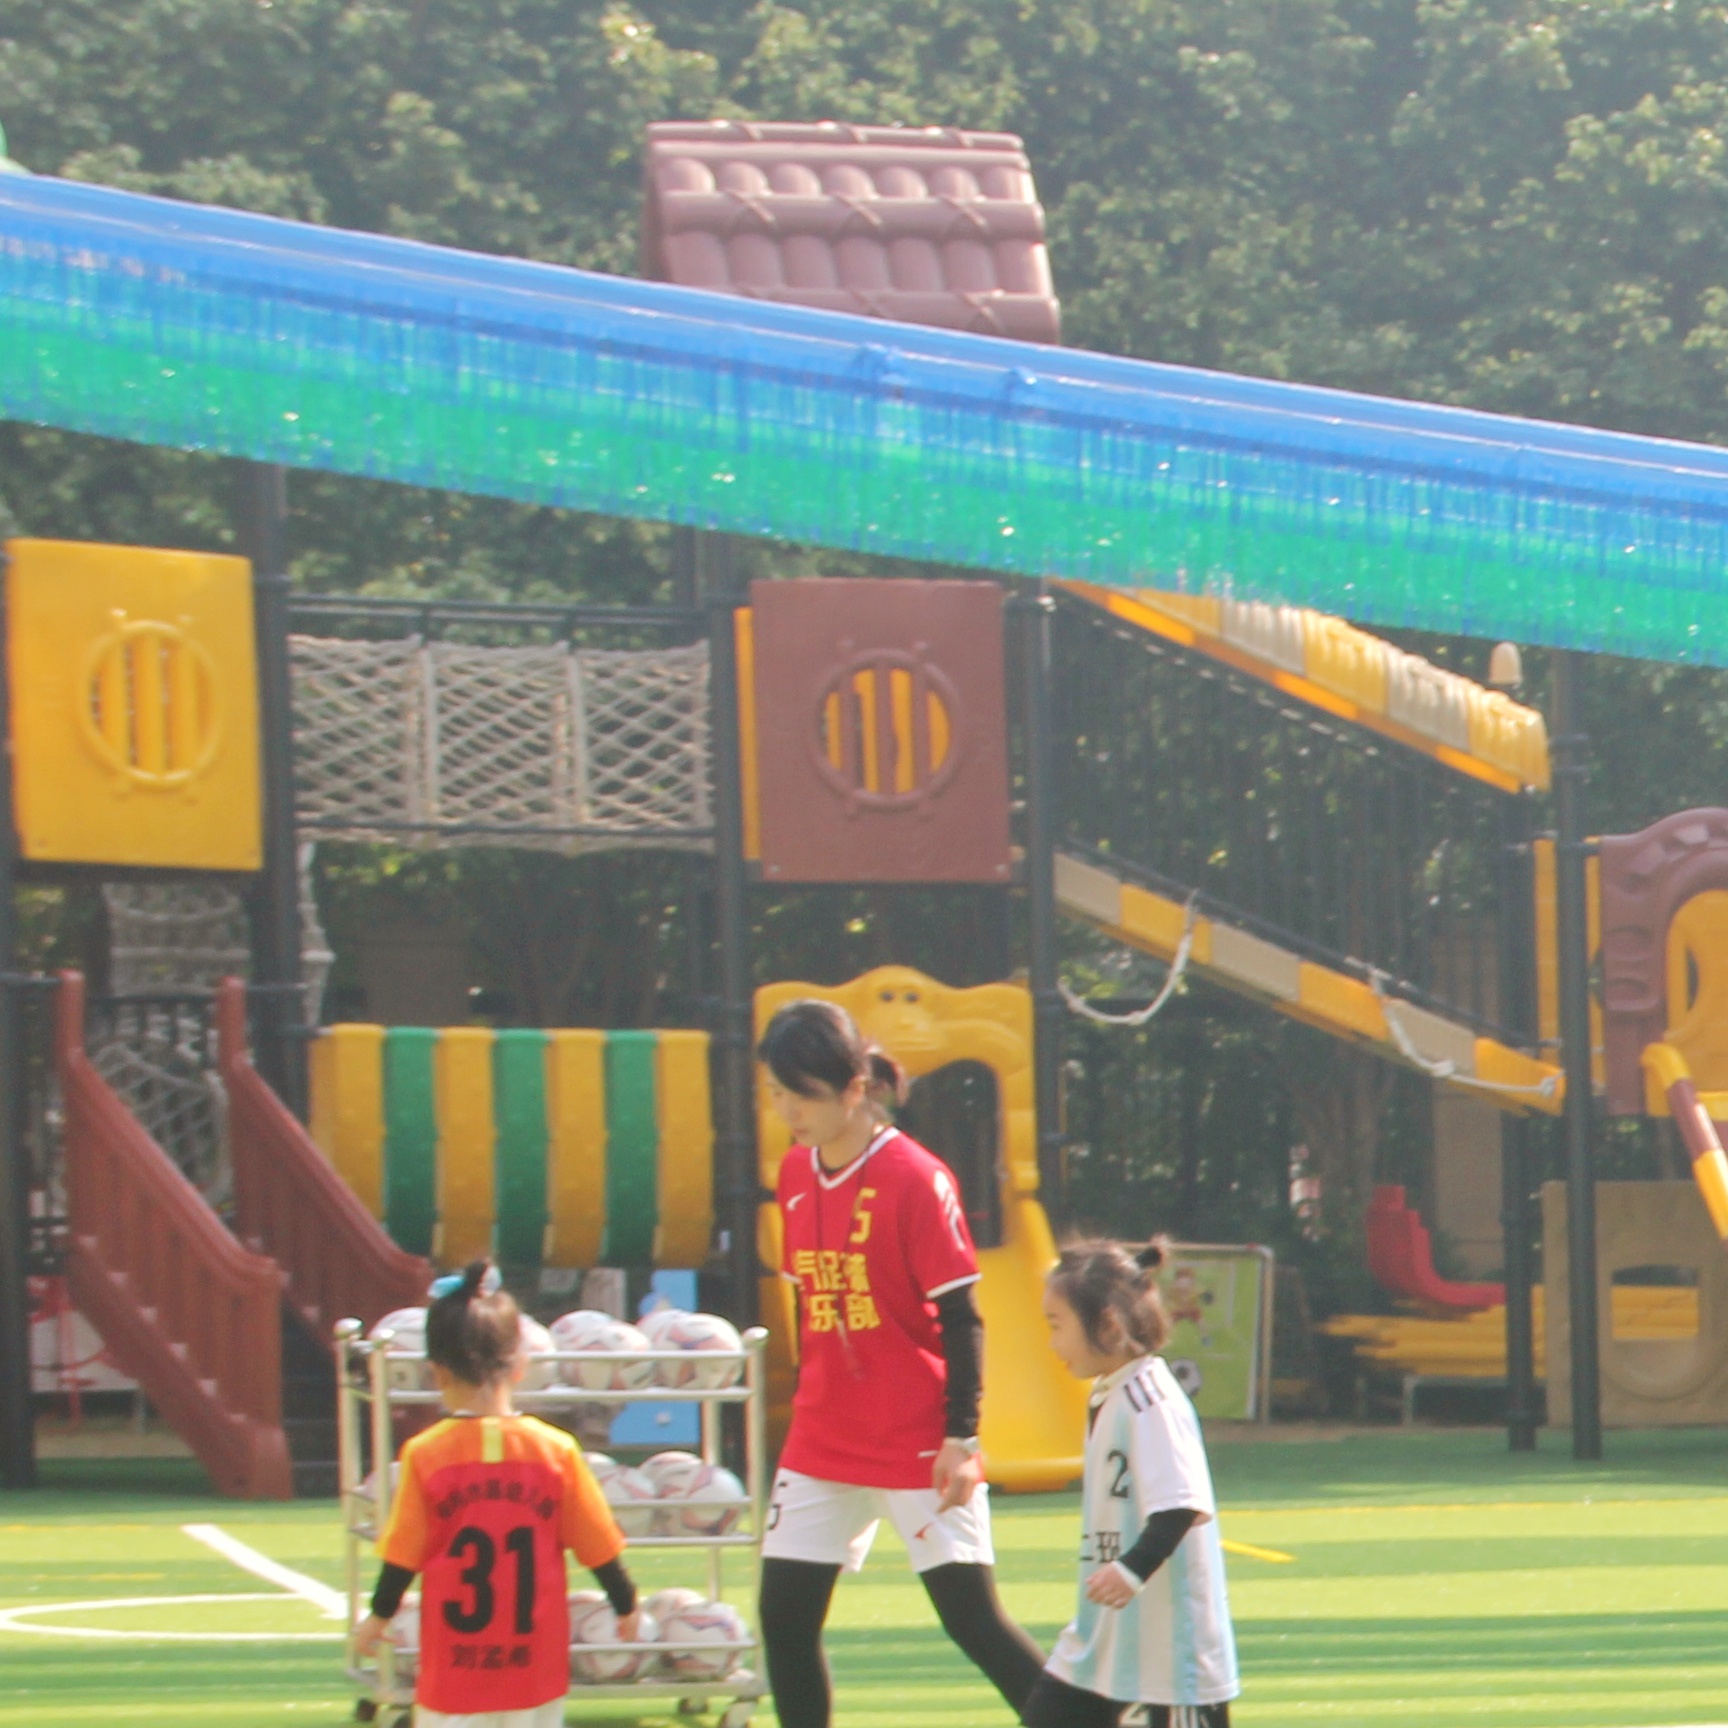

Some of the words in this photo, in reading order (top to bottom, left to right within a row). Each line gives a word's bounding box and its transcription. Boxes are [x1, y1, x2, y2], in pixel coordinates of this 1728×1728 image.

[853, 1187, 877, 1243] 5
[1107, 1449, 1128, 1498] 2
[443, 1525, 535, 1635] 31
